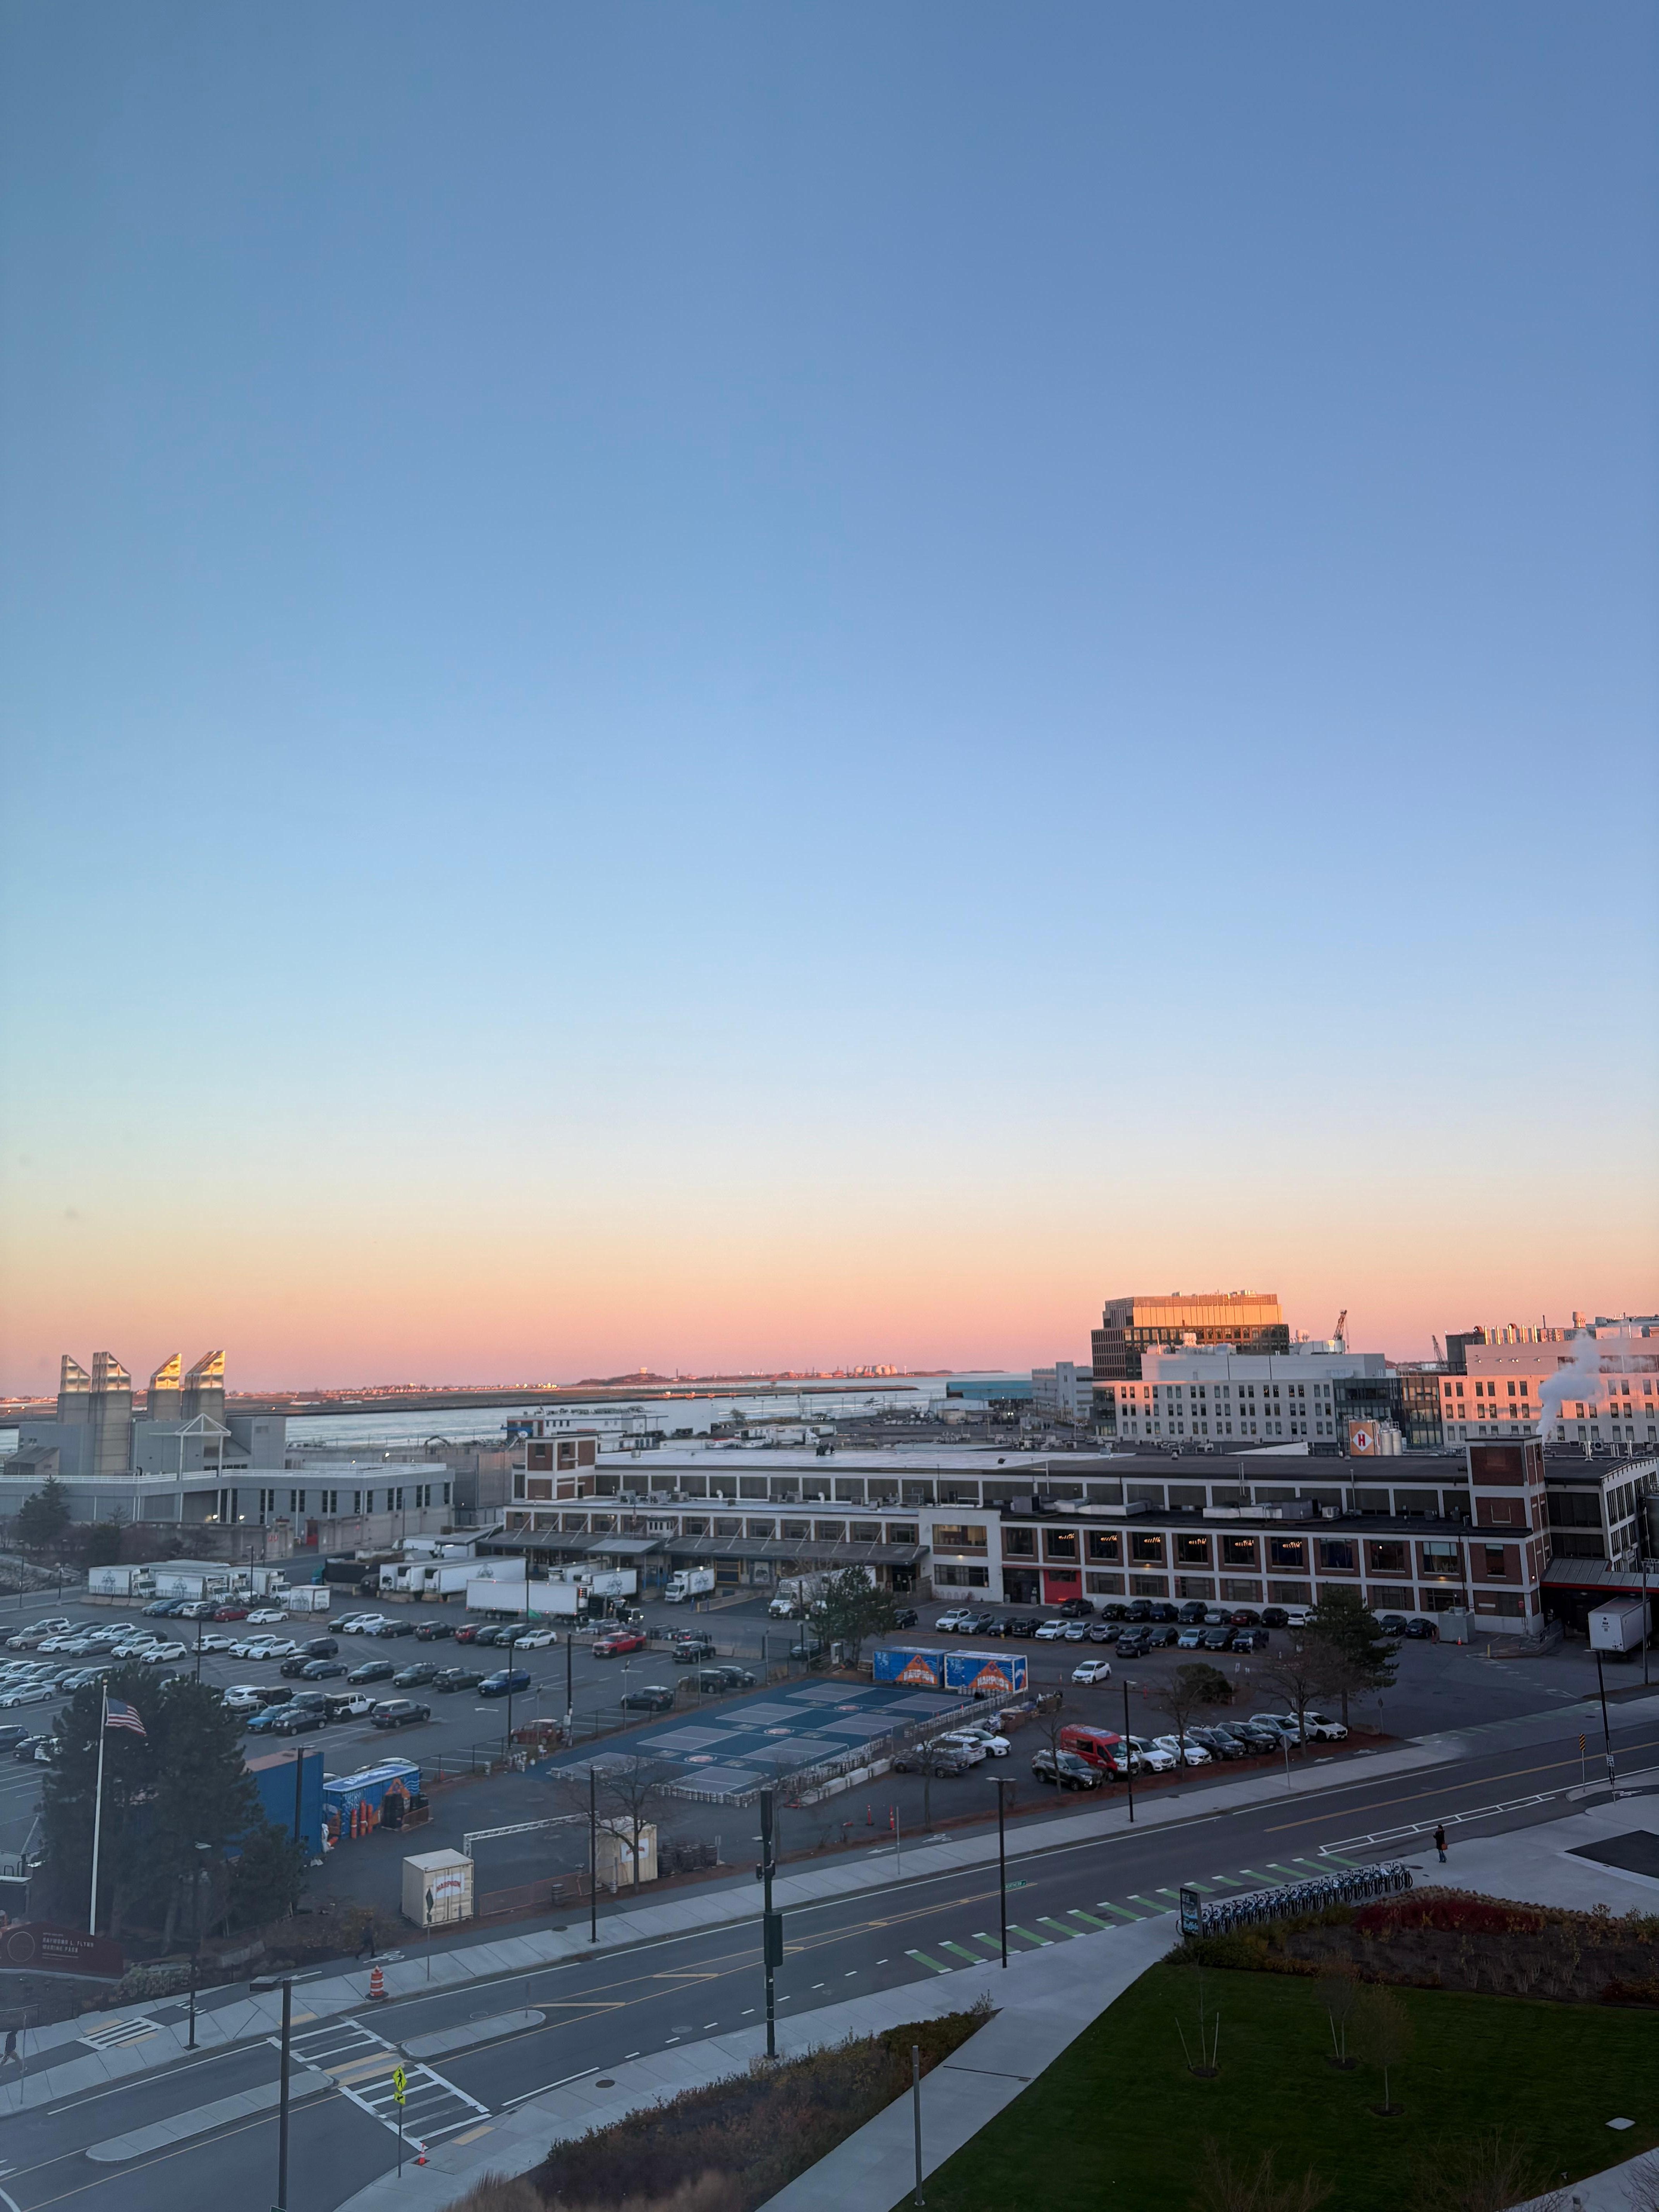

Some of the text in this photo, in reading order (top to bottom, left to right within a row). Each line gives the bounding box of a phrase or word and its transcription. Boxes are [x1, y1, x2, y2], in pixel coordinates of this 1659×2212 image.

[1358, 1434, 1365, 1446] H
[903, 1669, 934, 1684] HARPOON
[977, 1675, 1009, 1691] HARPOON
